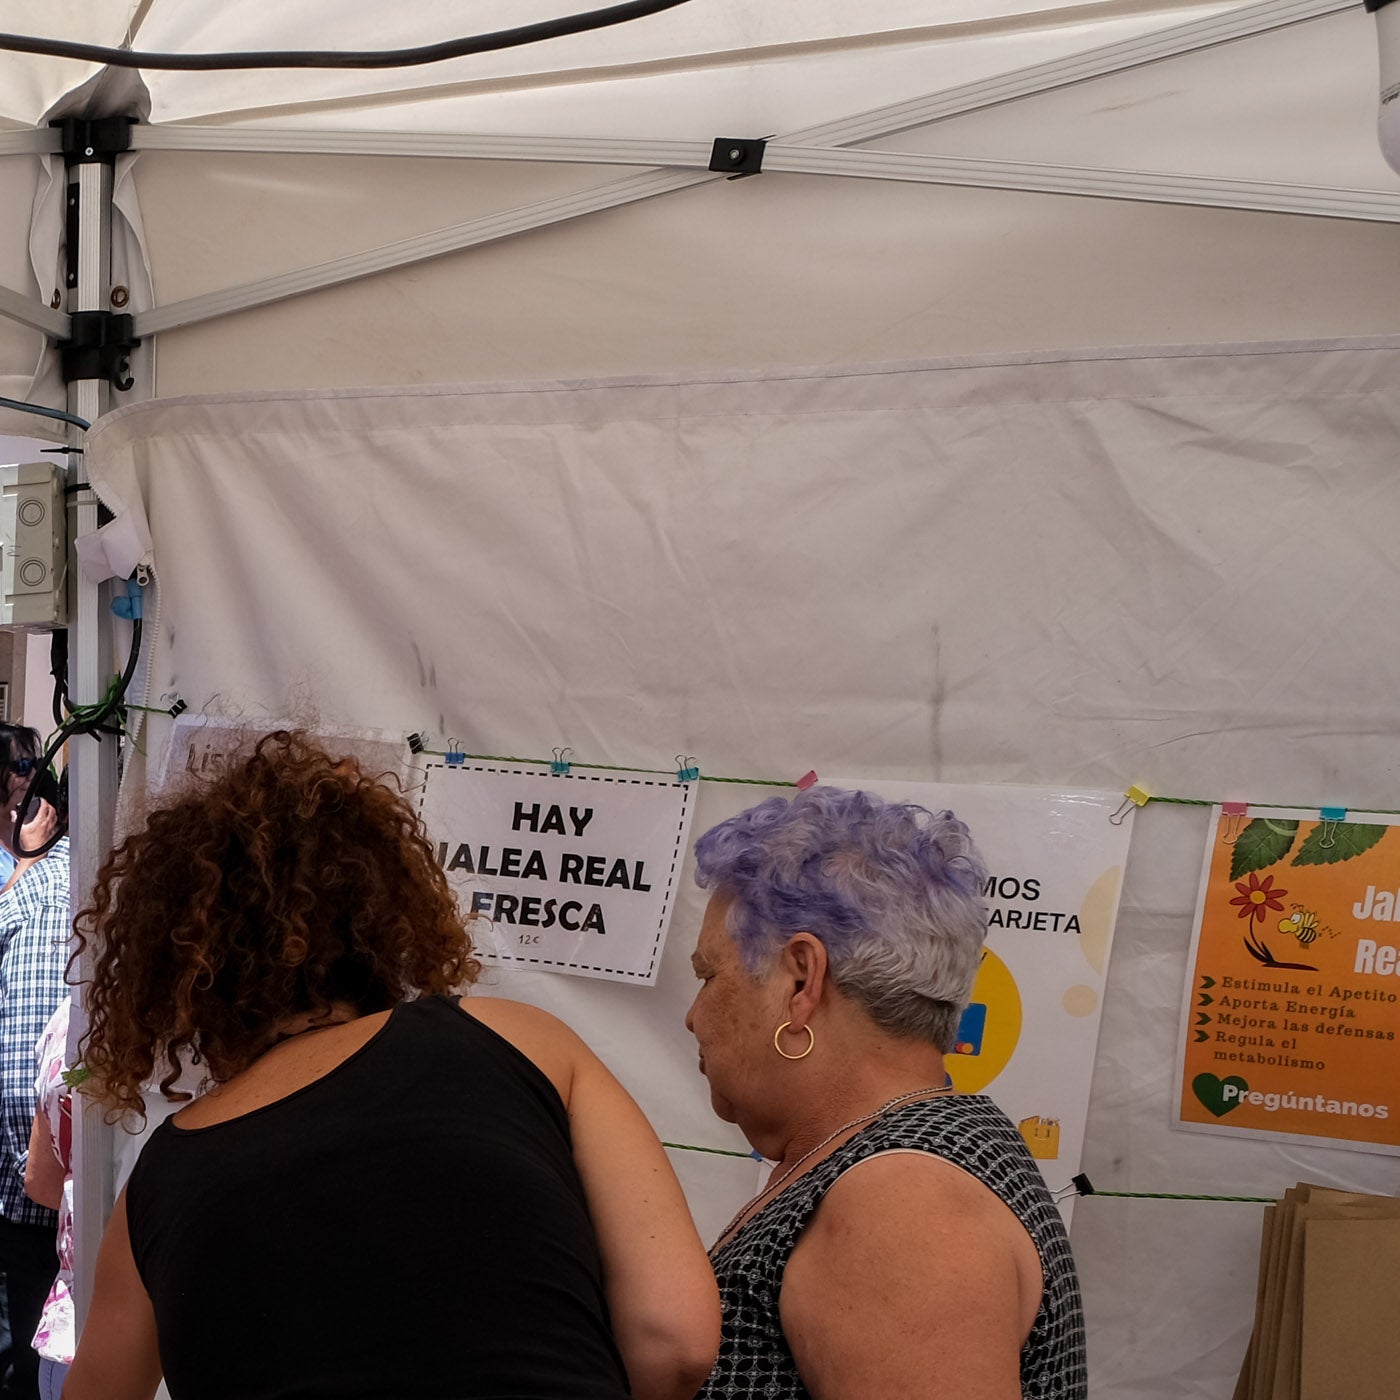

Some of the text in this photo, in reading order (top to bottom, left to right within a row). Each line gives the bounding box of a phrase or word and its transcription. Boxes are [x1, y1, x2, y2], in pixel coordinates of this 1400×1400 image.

[512, 802, 593, 836] HAY
[559, 853, 651, 892] REAL
[471, 891, 606, 934] FRESCA
[1222, 976, 1397, 1003] Estimula el Apetito
[1219, 995, 1356, 1019] Aporta Energía
[1215, 1031, 1297, 1049] Regula el
[1217, 1013, 1395, 1041] Mejora las defensas
[1214, 1050, 1325, 1070] metabolismo
[1223, 1084, 1389, 1120] Pregúntanos
